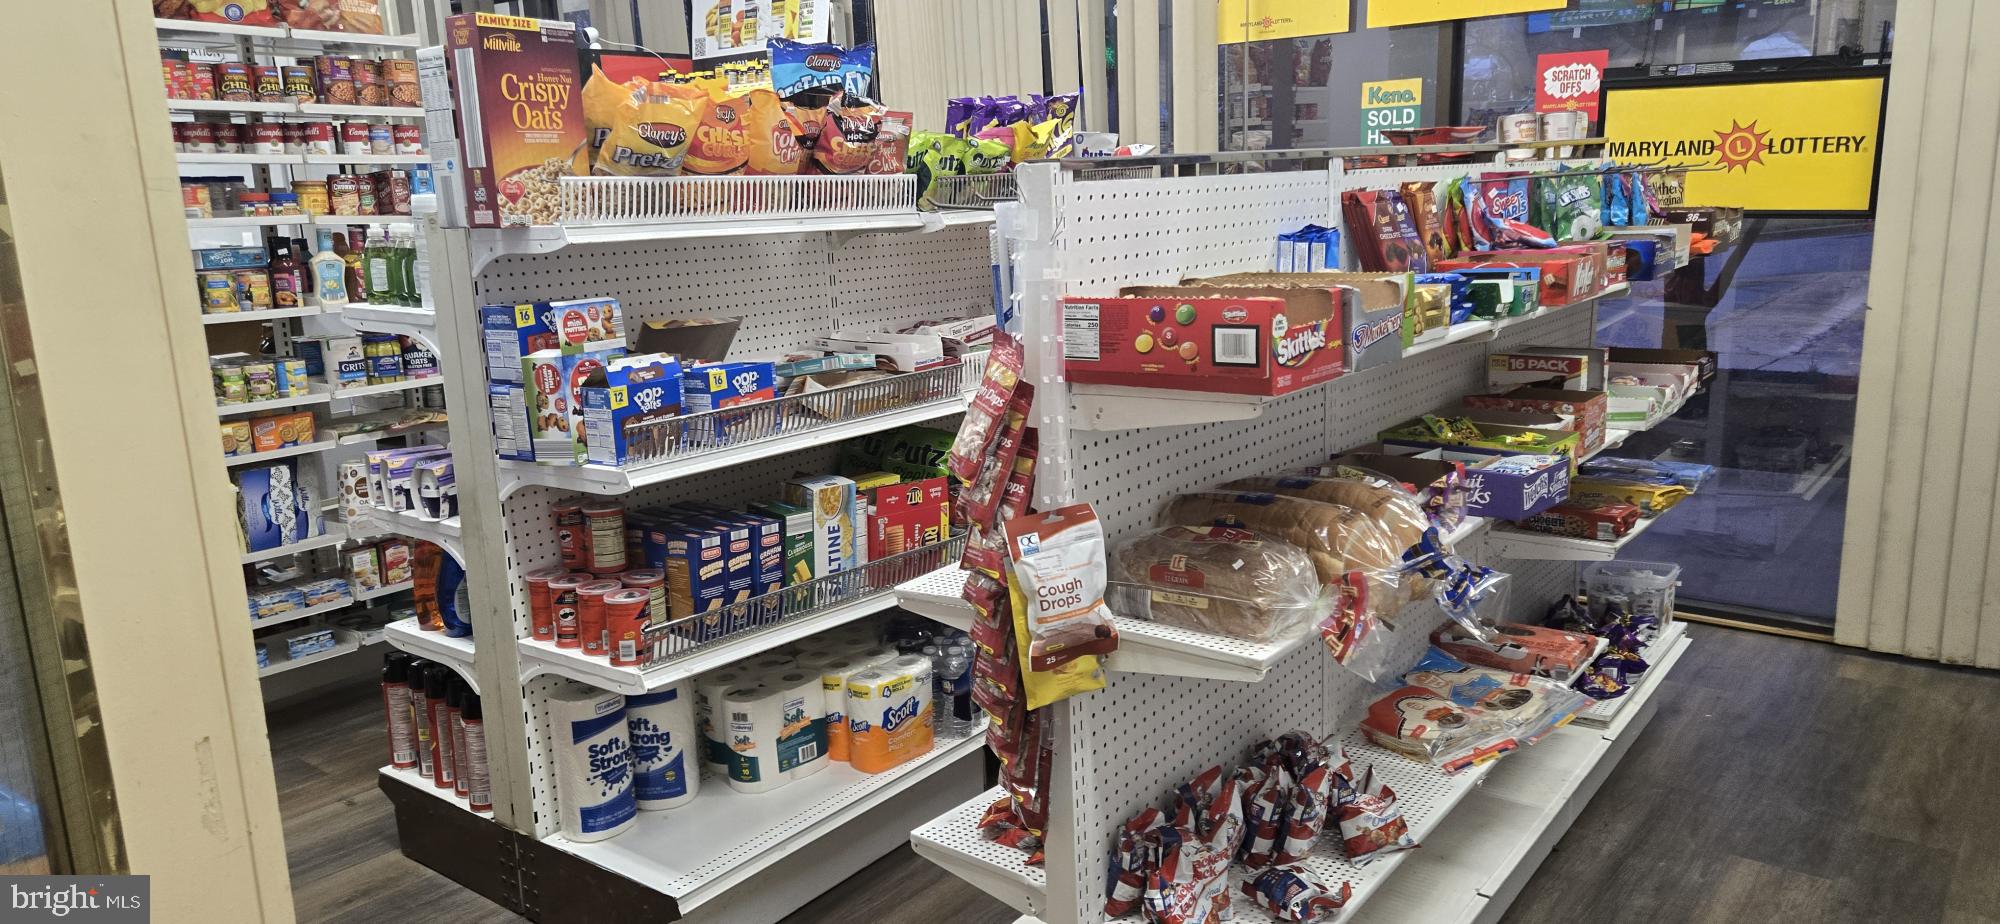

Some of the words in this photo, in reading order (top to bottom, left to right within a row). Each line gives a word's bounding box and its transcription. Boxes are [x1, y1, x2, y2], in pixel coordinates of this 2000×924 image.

[478, 15, 510, 28] FAMILY
[513, 18, 532, 29] SIZE
[484, 37, 521, 52] Millville
[805, 54, 842, 72] Clancy's
[537, 73, 559, 84] Honey
[561, 73, 573, 84] Nut
[1551, 69, 1591, 82] SCRATCH
[501, 72, 571, 109] Crispy
[1560, 81, 1582, 94] OFFS
[512, 101, 564, 130] Oats
[1367, 109, 1415, 127] SOLD
[638, 123, 687, 147] Clancy's
[1608, 139, 1715, 157] MARYLAND
[1769, 136, 1867, 155] LOTTERY
[519, 311, 530, 321] 16
[1277, 326, 1327, 364] Skittles
[1511, 358, 1525, 370] 16
[1527, 359, 1569, 372] PACK
[713, 377, 724, 386] 16
[613, 391, 624, 402] 12
[1037, 578, 1083, 599] Cough
[1040, 593, 1082, 612] Drops
[1046, 656, 1057, 665] 25
[887, 697, 914, 731] Scott
[588, 737, 621, 759] Soft
[590, 747, 633, 773] Strong
